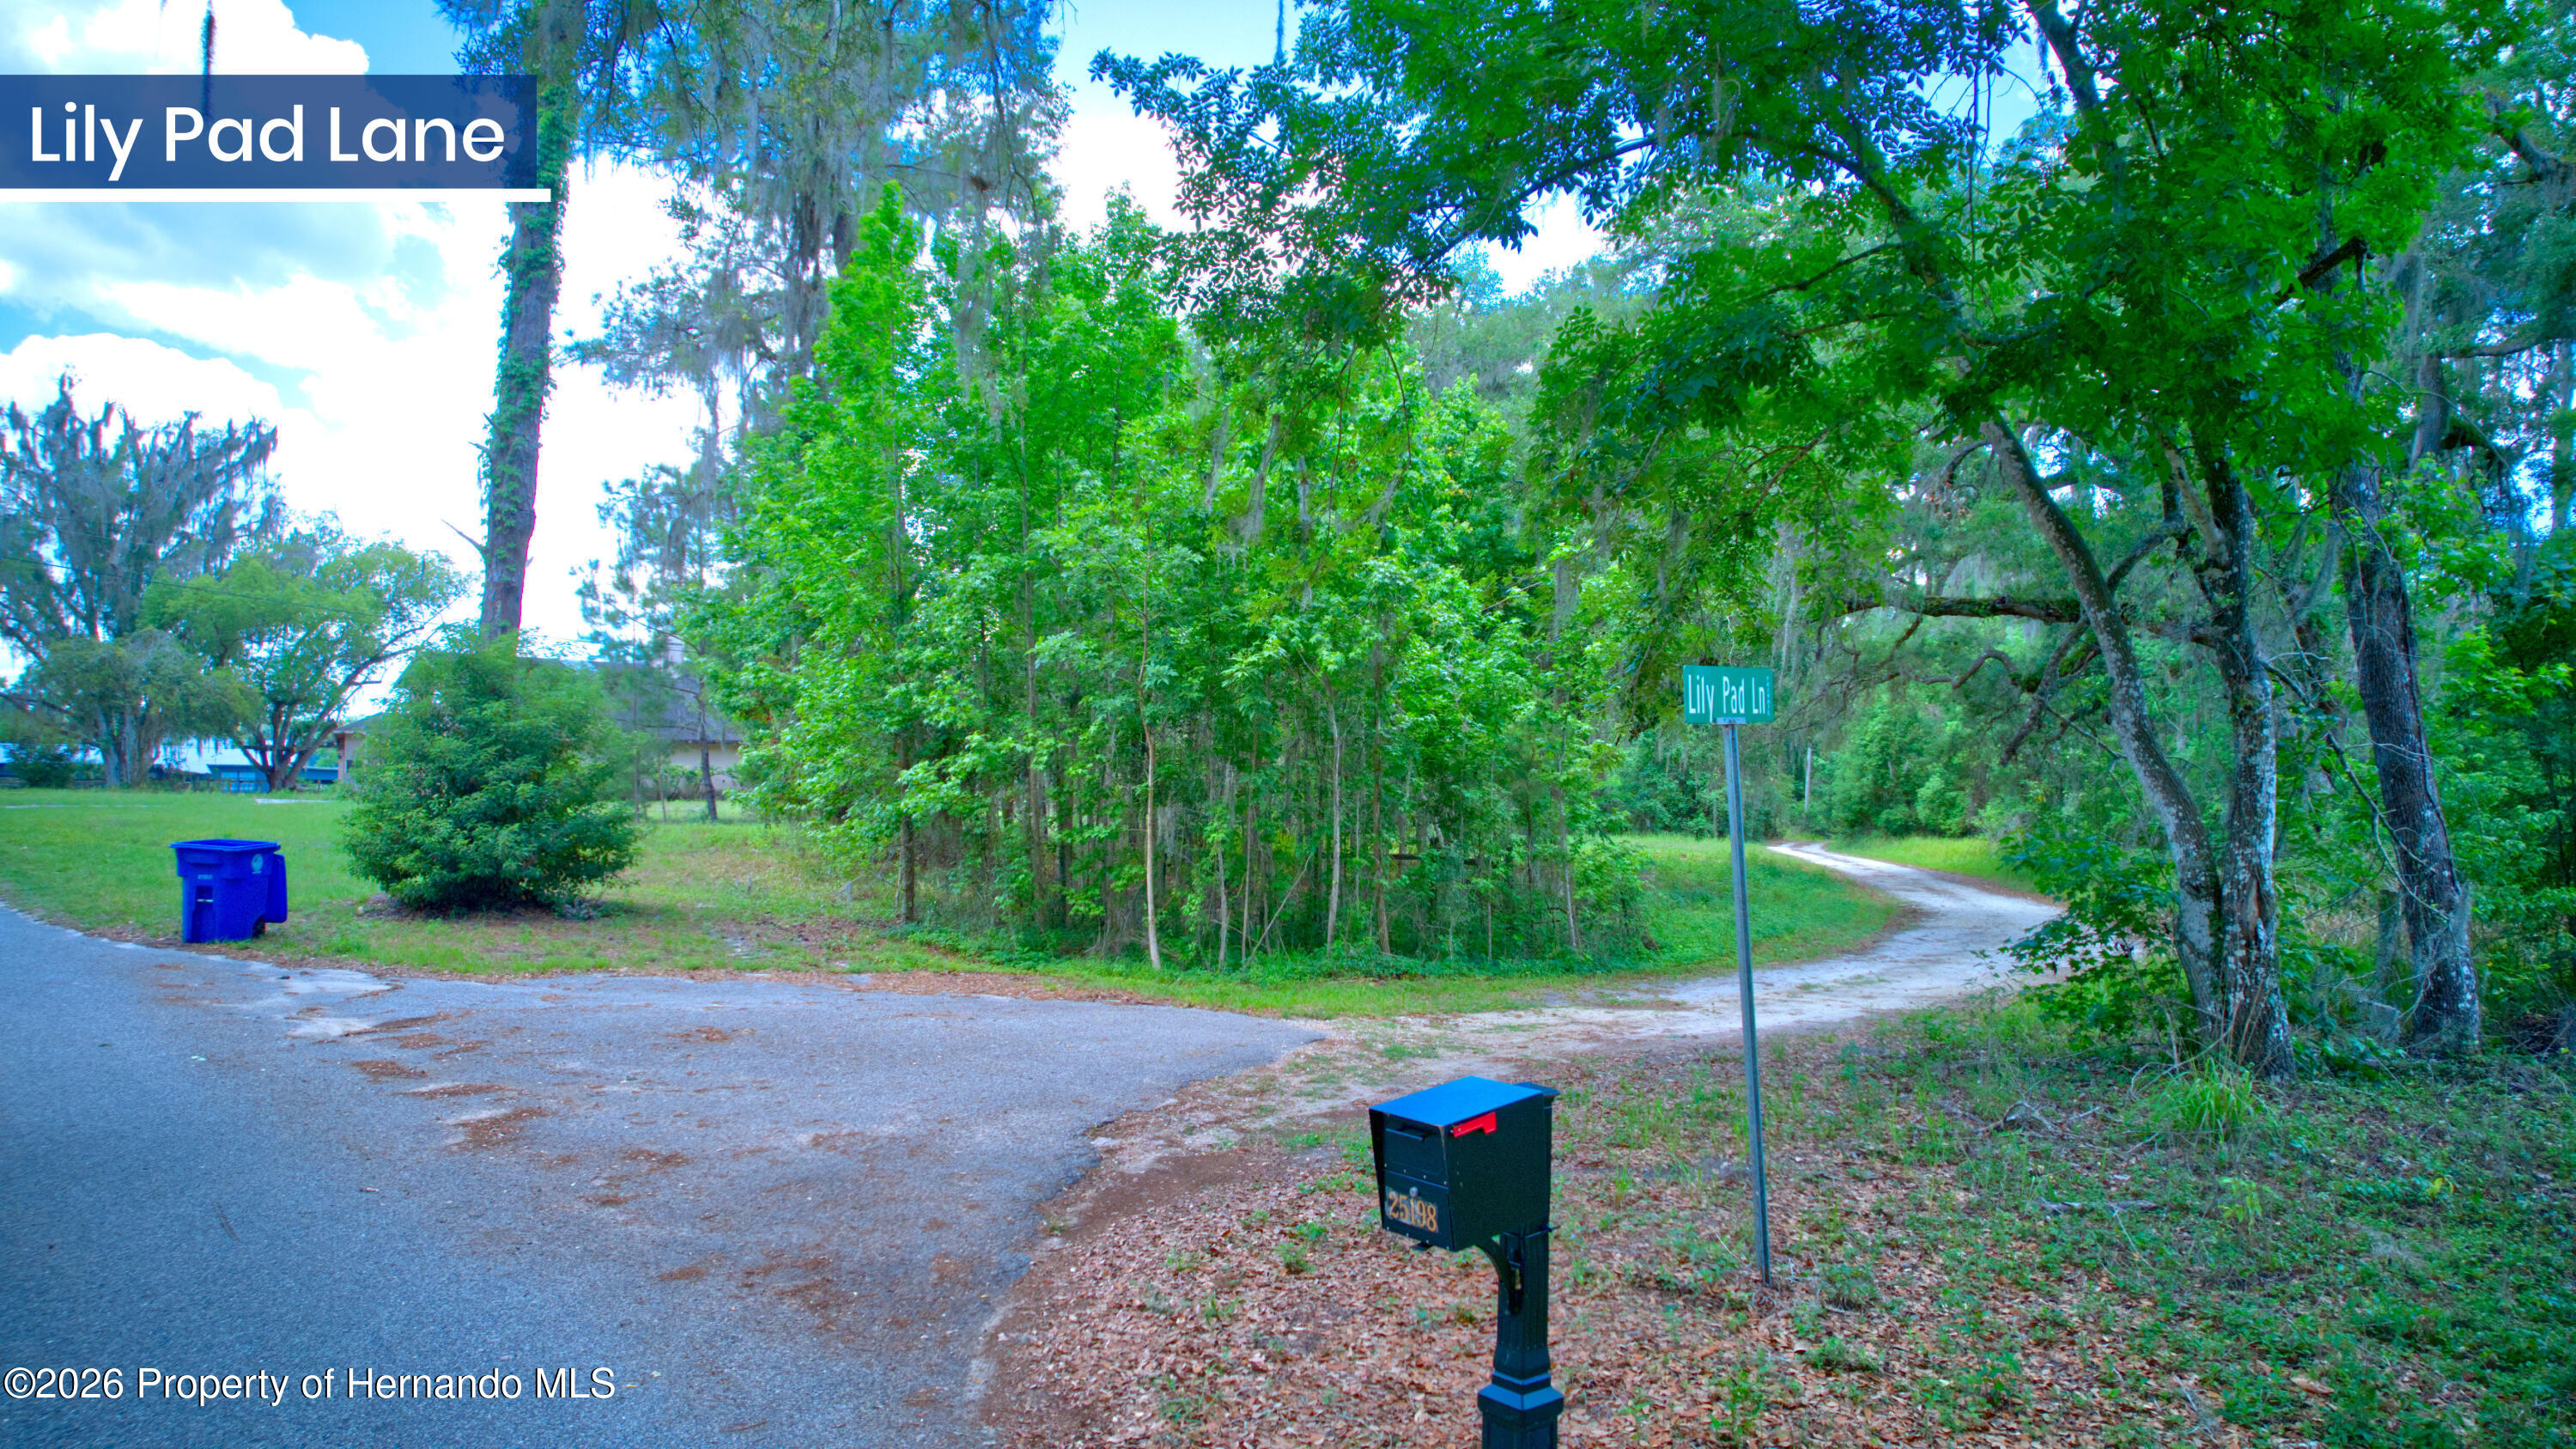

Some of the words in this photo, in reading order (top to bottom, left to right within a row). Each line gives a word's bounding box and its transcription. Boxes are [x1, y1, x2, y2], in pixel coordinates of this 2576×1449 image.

[1688, 674, 1715, 723] Lily
[1722, 676, 1745, 714] Pad
[1752, 677, 1765, 714] Ln
[1388, 1190, 1437, 1233] 25198
